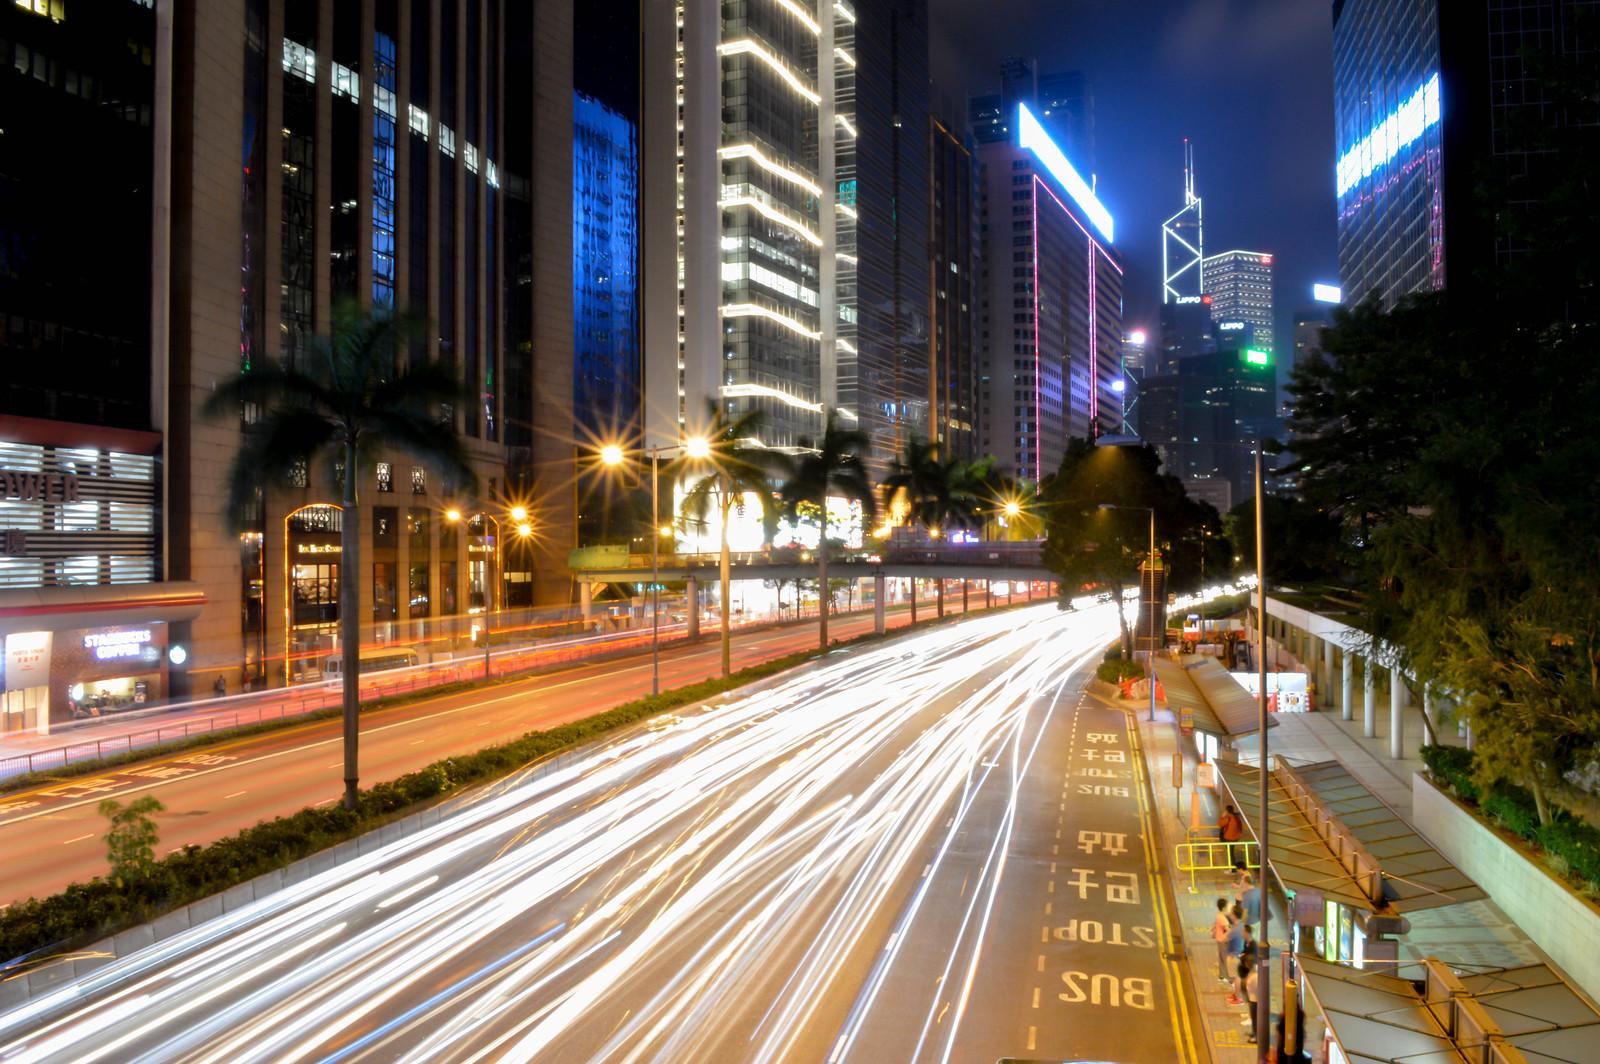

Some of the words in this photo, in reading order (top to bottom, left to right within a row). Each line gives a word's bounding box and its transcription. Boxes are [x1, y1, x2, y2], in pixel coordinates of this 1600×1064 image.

[1176, 296, 1201, 304] LIPPO
[1220, 322, 1244, 330] LIPPO
[1080, 748, 1126, 763] 巴士
[1077, 784, 1129, 797] BUS
[1077, 830, 1128, 856] 站
[1067, 868, 1140, 904] 巴士
[1053, 919, 1156, 948] STOP
[1058, 970, 1155, 1011] BUS
